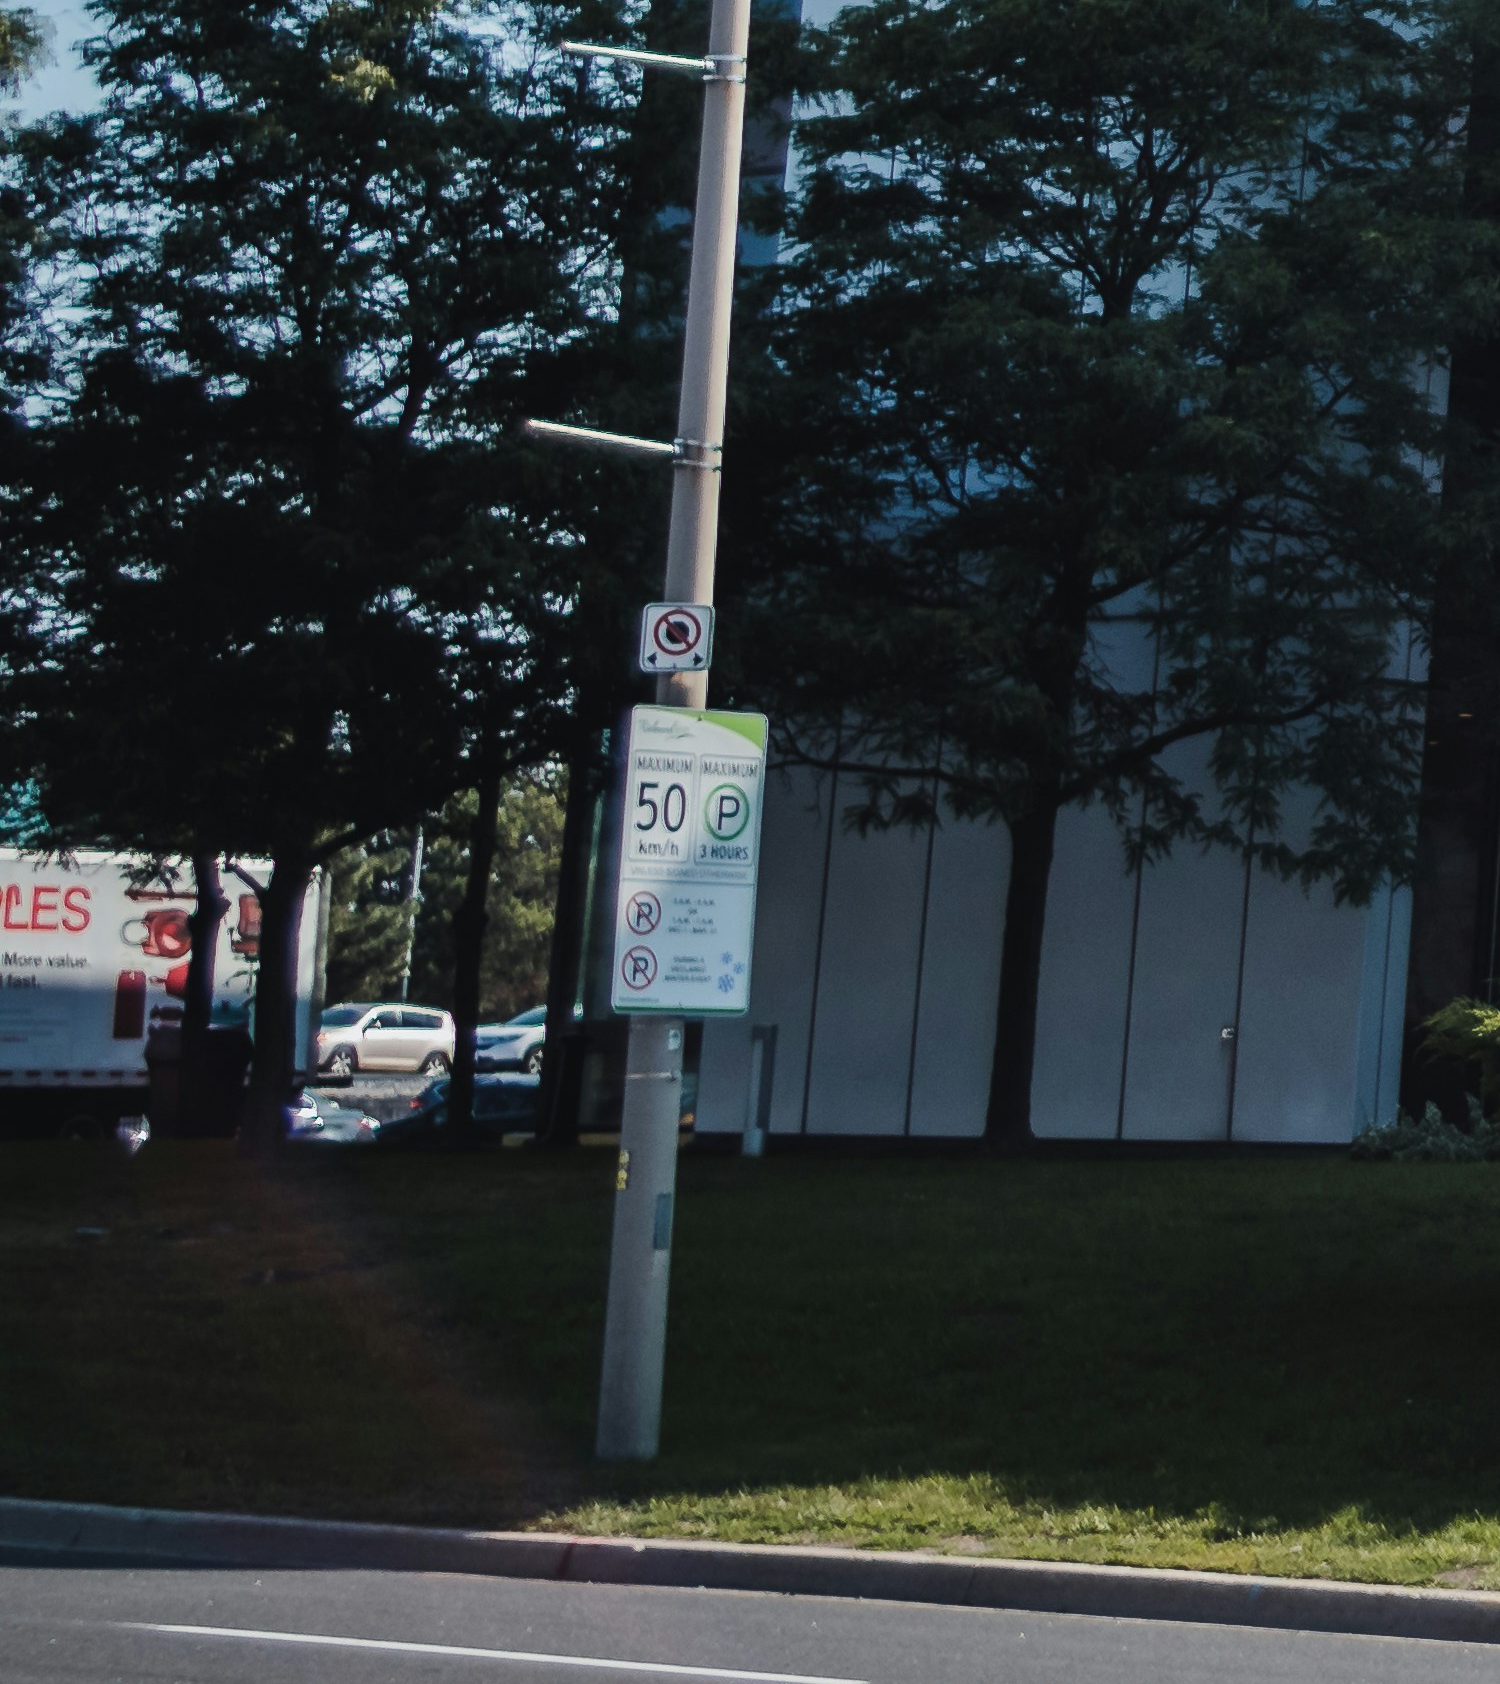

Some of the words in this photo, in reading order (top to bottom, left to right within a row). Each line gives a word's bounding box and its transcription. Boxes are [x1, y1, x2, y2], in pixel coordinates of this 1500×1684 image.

[637, 756, 693, 773] MAXIMUM
[702, 760, 758, 778] MAXIMUM
[635, 782, 686, 832] 50
[639, 838, 679, 857] km/h
[700, 844, 707, 858] 3
[711, 844, 749, 860] HOURS
[0, 883, 91, 932] LES
